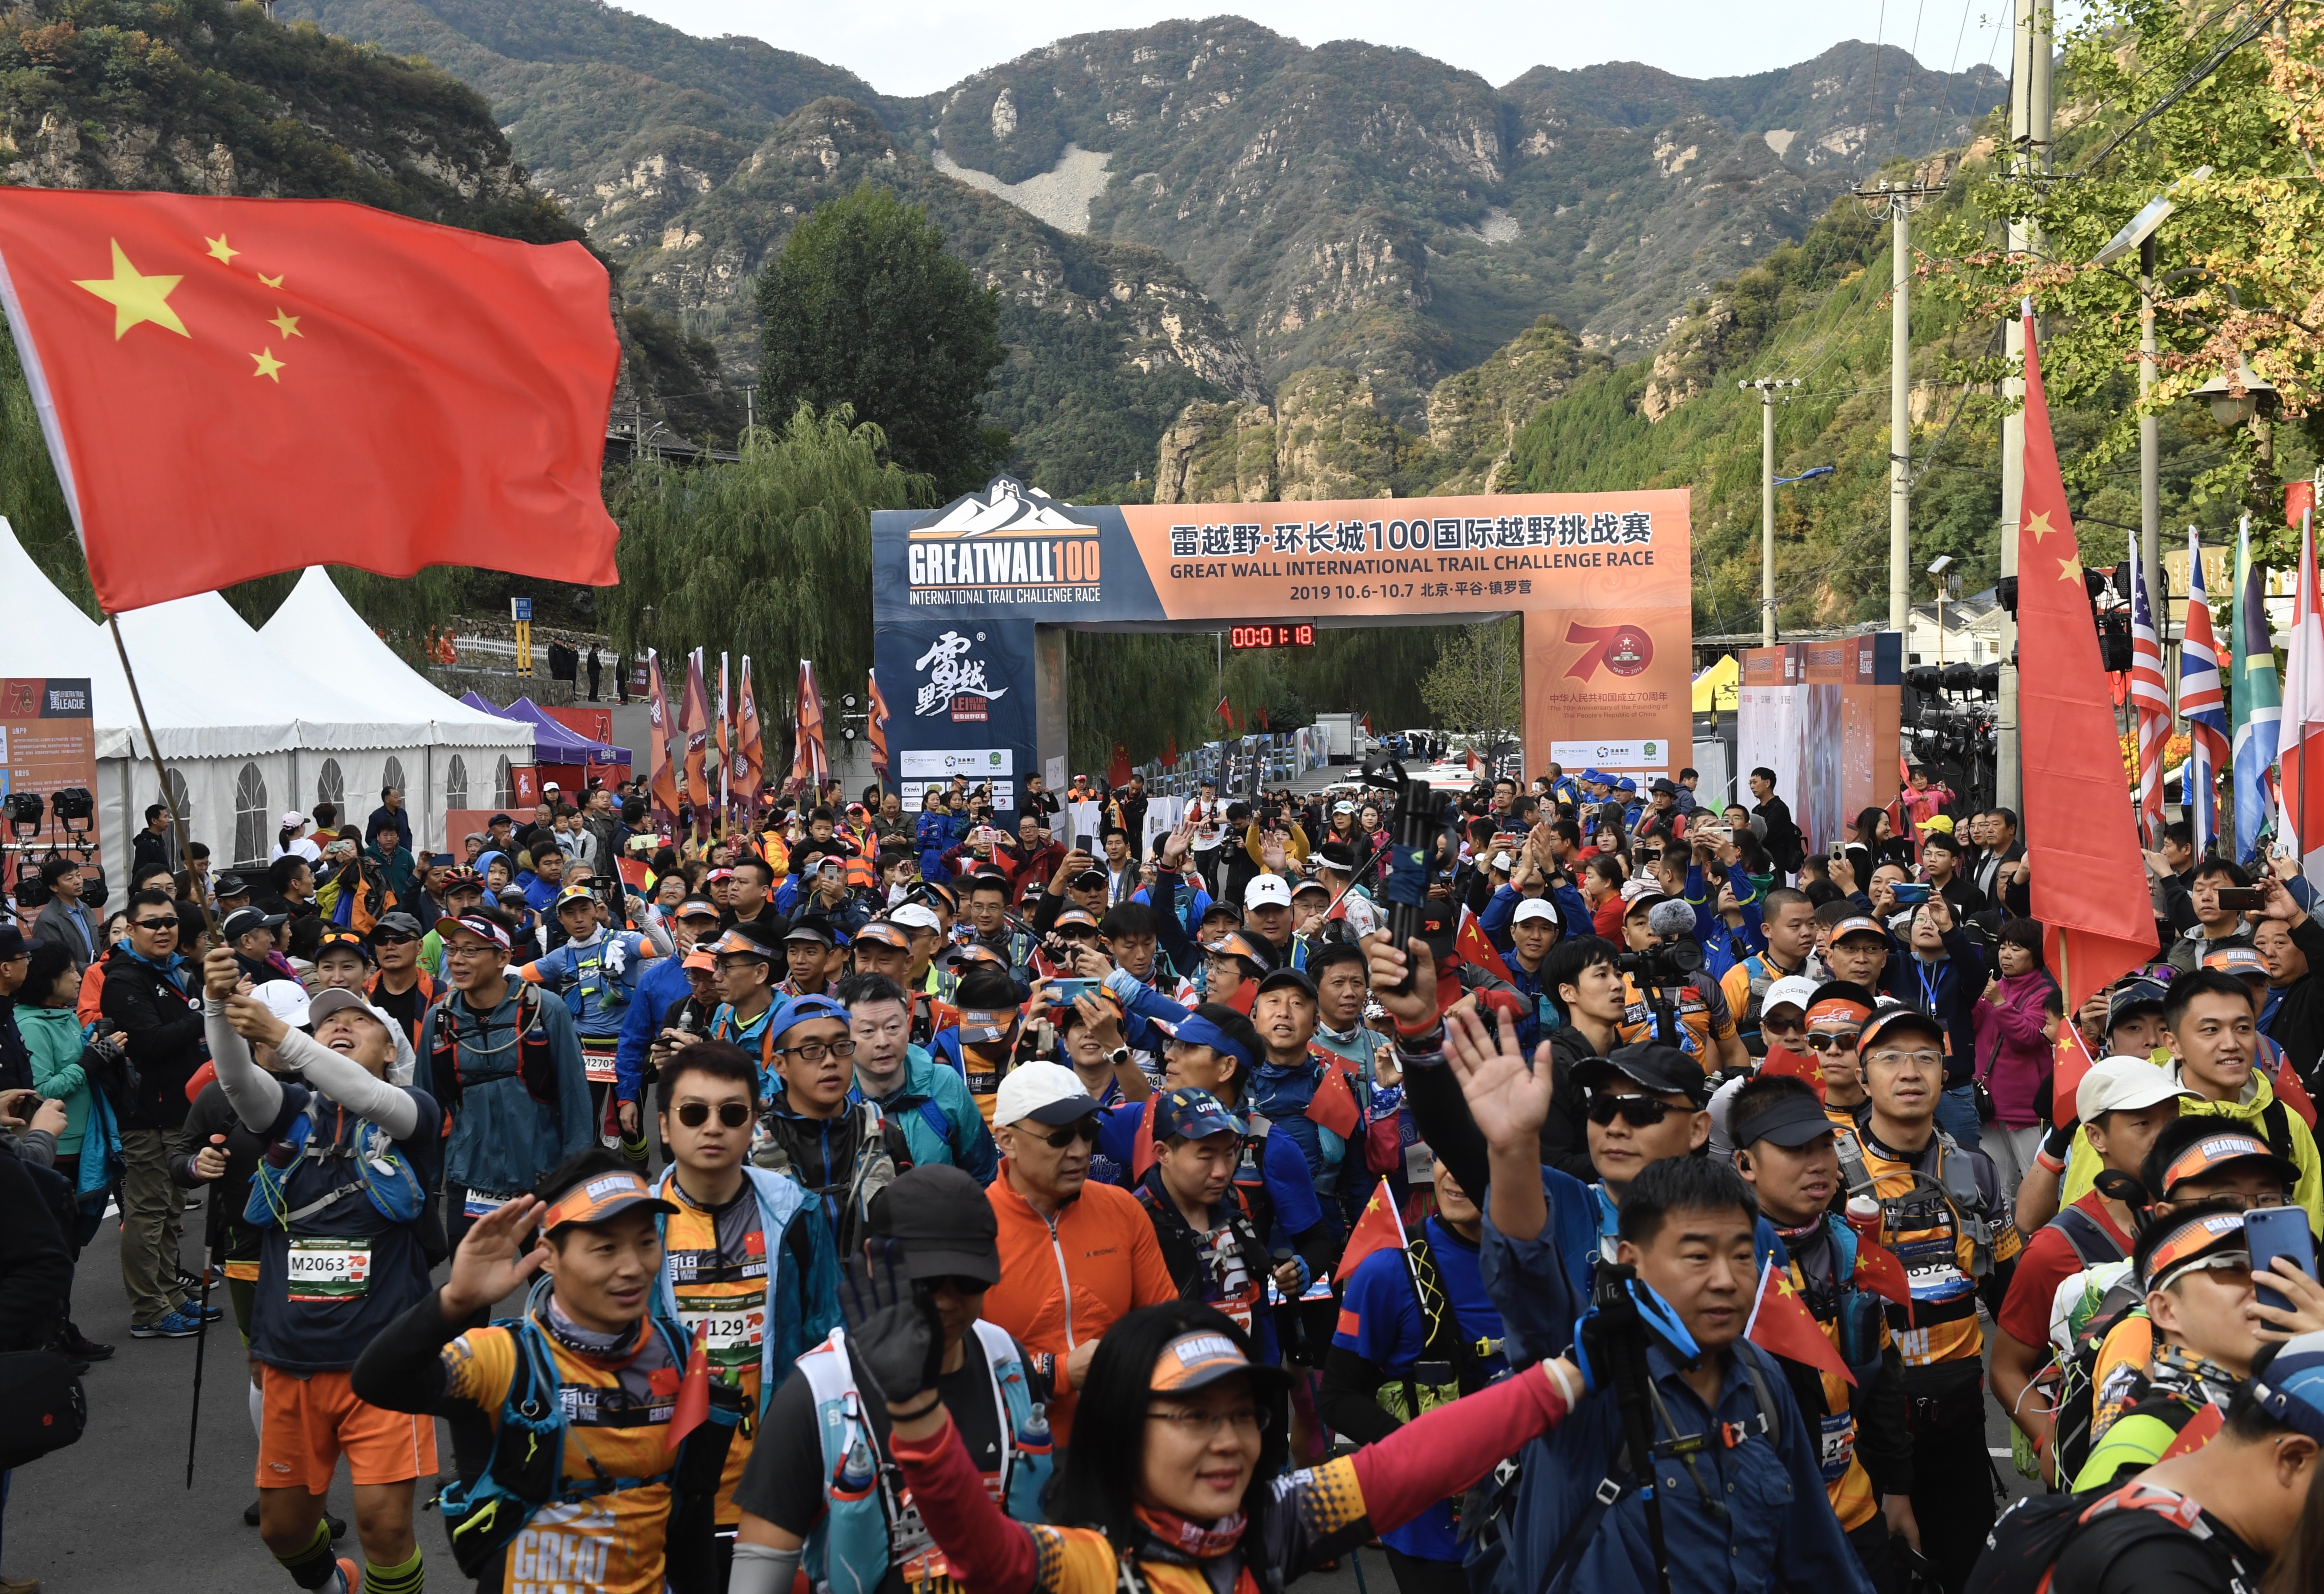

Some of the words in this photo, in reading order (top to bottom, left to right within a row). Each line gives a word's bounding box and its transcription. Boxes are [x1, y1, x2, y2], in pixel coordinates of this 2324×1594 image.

[1170, 511, 1652, 557] 雷越野·环长城100国际越野挑战赛
[909, 541, 1100, 585] GREATWALL100
[1170, 563, 1227, 579] GREAT
[1232, 562, 1281, 577] WALL
[1287, 558, 1433, 576] INTERNATIONAL
[1437, 556, 1489, 572] TRAIL
[1495, 552, 1601, 570] CHALLENGE
[1607, 551, 1654, 566] RACE
[910, 589, 985, 605] INTERNATIONAL
[987, 588, 1015, 603] TRAIL
[1017, 588, 1073, 603] CHALLENGE
[1075, 587, 1101, 602] RACE
[1290, 585, 1330, 600] 2019
[1335, 584, 1414, 599] 10.6-10.7
[1421, 580, 1532, 597] 北京·平谷·镇罗营
[1563, 621, 1654, 683] 70
[1612, 666, 1624, 675] 1949
[1630, 666, 1643, 674] 2019
[60, 699, 85, 709] LEAGUE
[951, 697, 969, 711] LEI
[1550, 692, 1668, 703] 中华人民共和国成立70周年
[1257, 754, 1266, 796] FENIX
[291, 1257, 345, 1271] M2063
[680, 1256, 697, 1268] LEI
[513, 1529, 615, 1584] GREAT
